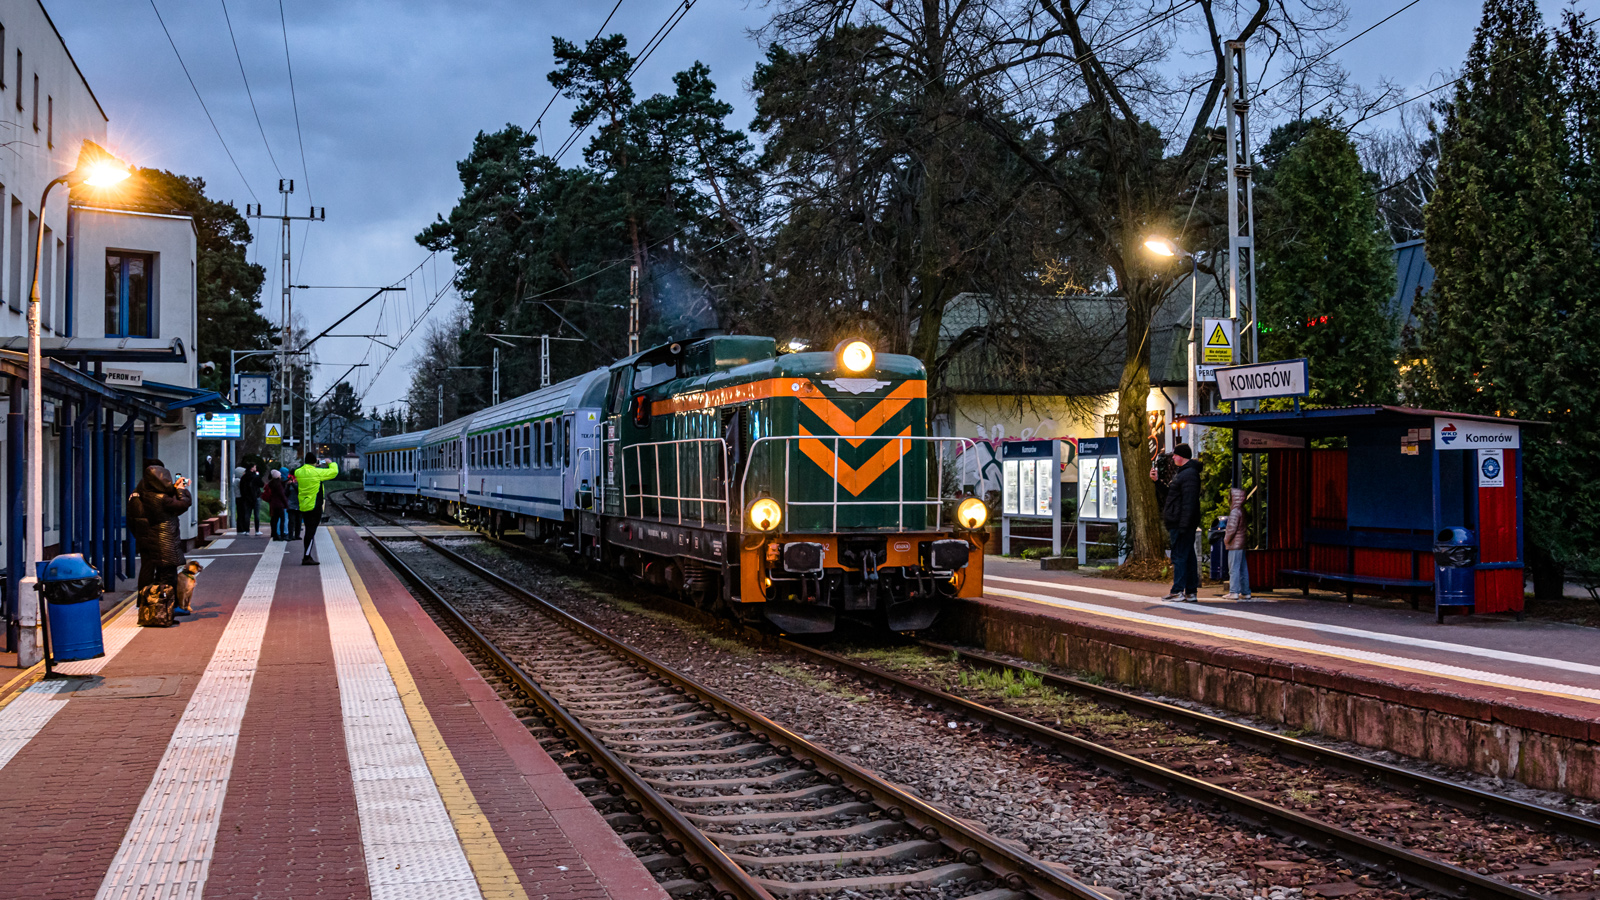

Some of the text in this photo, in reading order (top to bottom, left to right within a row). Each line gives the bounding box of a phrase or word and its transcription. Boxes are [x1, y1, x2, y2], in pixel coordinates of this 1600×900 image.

[1198, 369, 1213, 377] PERO
[1229, 367, 1291, 391] KOMORÓW
[1465, 433, 1512, 443] Komorów
